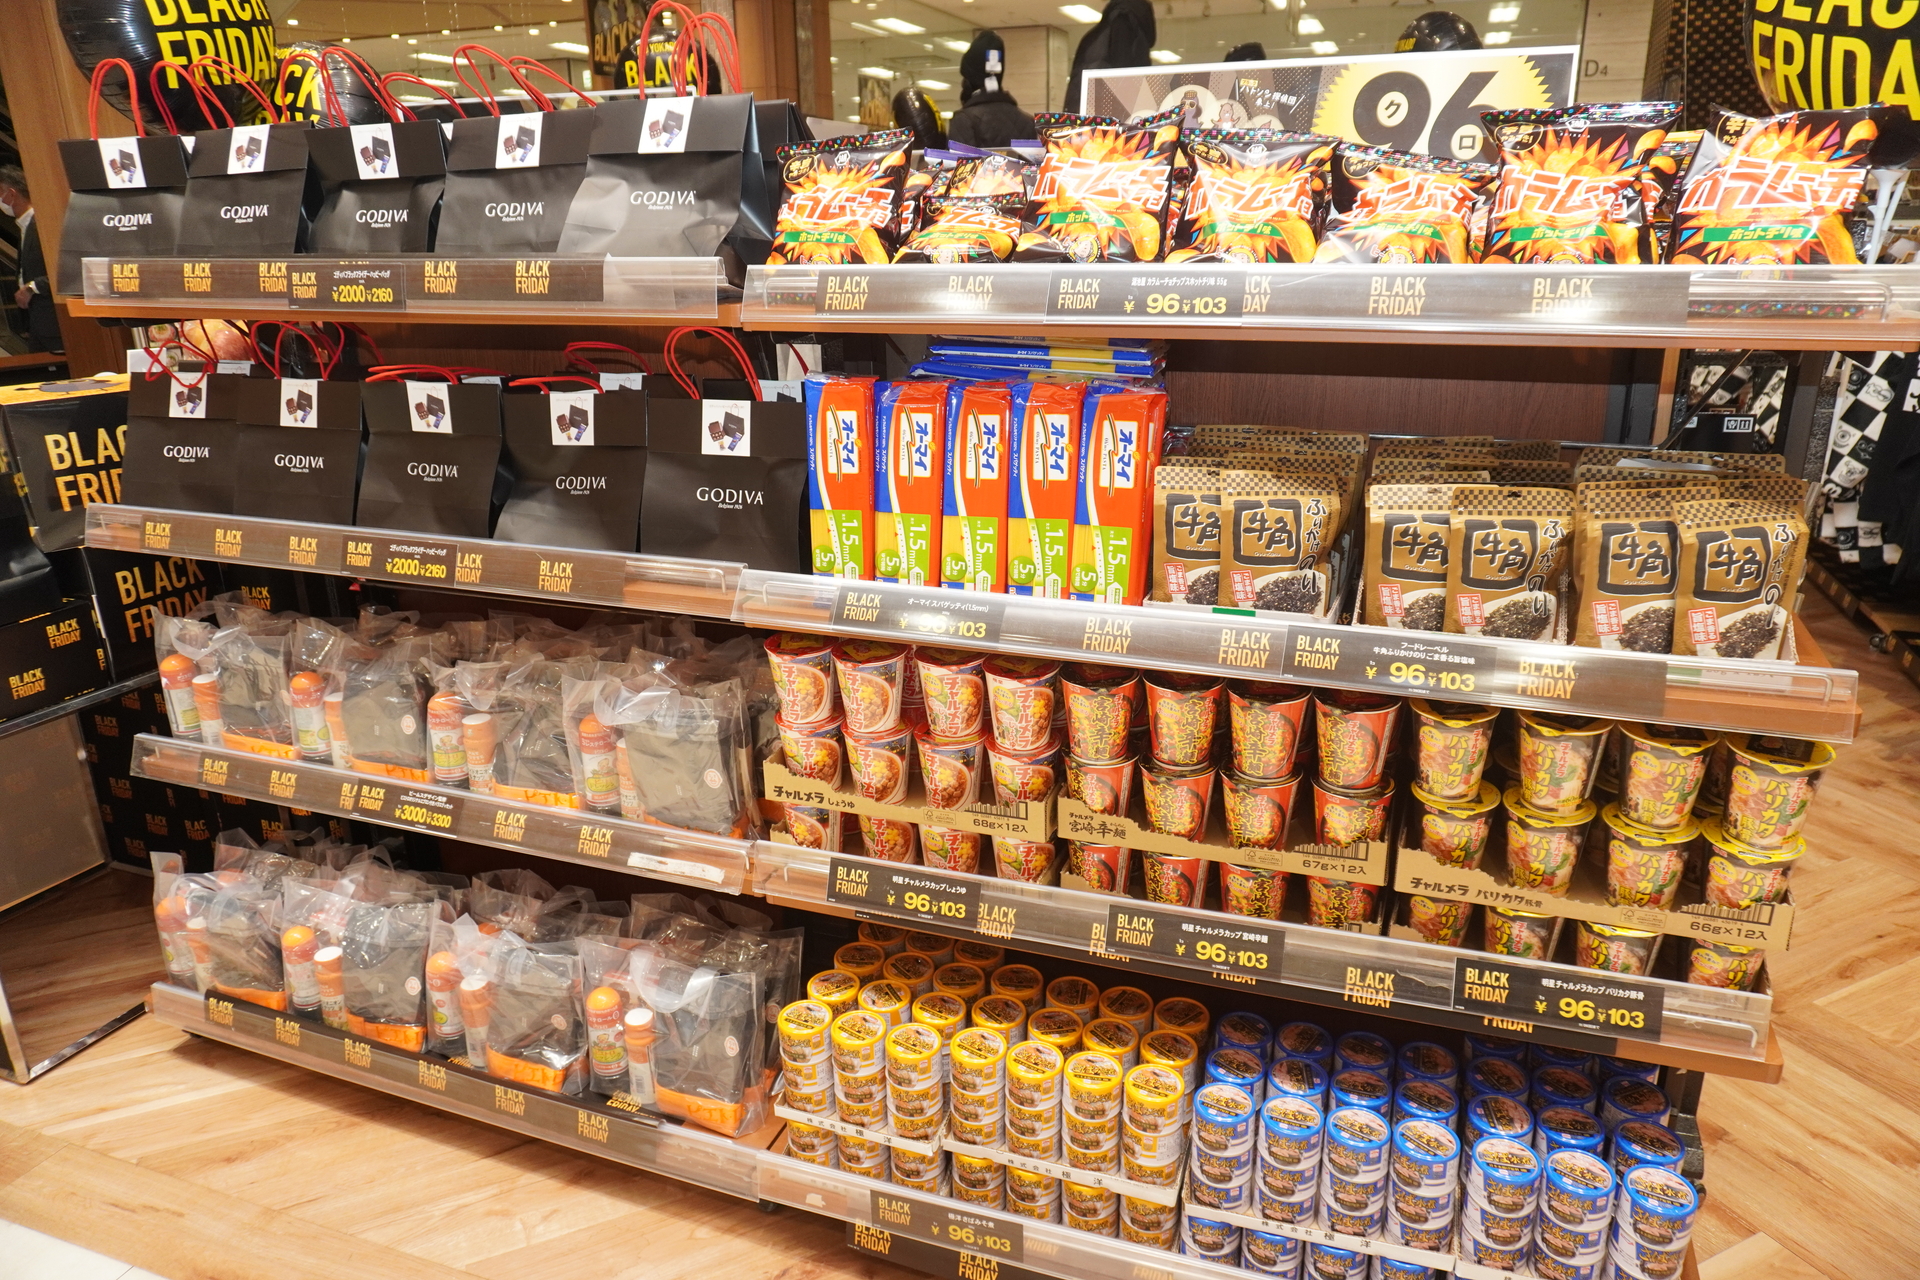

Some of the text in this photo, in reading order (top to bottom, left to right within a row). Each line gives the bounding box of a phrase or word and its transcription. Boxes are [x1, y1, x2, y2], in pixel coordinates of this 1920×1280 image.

[1352, 70, 1499, 163] 96
[1385, 99, 1401, 119] ク
[630, 190, 697, 205] GODIVA
[220, 204, 269, 219] GODIVA
[355, 209, 408, 223] GODIVA
[485, 201, 544, 217] GODIVA
[103, 213, 153, 226] GODIVA
[1728, 225, 1805, 241] ホットチリ味
[112, 264, 139, 278] BLACK
[184, 263, 212, 277] BLACK
[259, 262, 287, 277] BLACK
[292, 272, 317, 284] BLACK
[424, 261, 457, 277] BLACK
[515, 260, 550, 277] BLACK
[184, 278, 211, 292] FRIDAY
[259, 277, 287, 292] FRIDAY
[292, 285, 317, 298] FRIDAY
[424, 277, 457, 294] FRIDAY
[515, 277, 549, 294] FRIDAY
[827, 276, 870, 294] BLACK
[1370, 276, 1427, 296] BLACK
[1533, 277, 1594, 298] BLACK
[825, 293, 867, 310] FRIDAY
[1058, 294, 1099, 309] FRIDAY
[1146, 293, 1181, 314] 96
[1368, 296, 1426, 316] FRIDAY
[164, 445, 210, 458] GODIVA
[841, 418, 858, 469] オーマイ
[915, 420, 929, 470] オーマイ
[982, 423, 997, 474] オーマイ
[1050, 422, 1066, 474] オーマイ
[274, 454, 324, 469] GODIVA
[1117, 428, 1134, 482] オーマイ
[407, 462, 459, 478] GODIVA
[556, 475, 607, 490] GODIVA
[696, 487, 764, 505] GODIVA
[215, 528, 242, 543] BLACK
[1242, 510, 1297, 552] 牛角
[145, 535, 170, 549] FRIDAY
[215, 542, 242, 557] FRIDAY
[289, 536, 317, 552] BLACK
[840, 519, 859, 563] 1.5mm
[907, 522, 927, 568] 1.5mm
[975, 526, 994, 571] 1.5mm
[1044, 527, 1064, 574] 1.5mm
[1299, 498, 1328, 595] ふりかけのり
[1393, 525, 1448, 566] 牛角
[289, 550, 317, 565] FRIDAY
[346, 554, 371, 567] FRIDAY
[1106, 537, 1127, 583] 1.5mm
[1473, 531, 1528, 574] 牛角
[1611, 535, 1671, 579] 牛角
[1527, 519, 1565, 617] ふりかけのり
[1708, 542, 1764, 587] 牛角
[539, 576, 572, 593] FRIDAY
[846, 592, 882, 607] BLACK
[843, 606, 879, 622] FRIDAY
[46, 617, 79, 638] BLACK
[1085, 616, 1132, 636] BLACK
[49, 630, 82, 649] FRIDAY
[1082, 633, 1131, 654] FRIDAY
[1220, 628, 1271, 650] BLACK
[1296, 635, 1341, 654] BLACK
[1400, 642, 1449, 653] フードレーベル
[1218, 648, 1270, 669] FRIDAY
[1294, 652, 1340, 671] FRIDAY
[1373, 646, 1476, 665] 牛角ふりかけのりごま香る旨塩味
[1365, 666, 1378, 679] ¥
[1389, 662, 1426, 685] 96
[1519, 656, 1577, 679] BLACK
[11, 680, 45, 700] FRIDAY
[781, 665, 801, 724] チャルメラ
[1517, 677, 1576, 699] FRIDAY
[847, 671, 864, 731] チャルメラ
[944, 675, 961, 736] チャルメラ
[1017, 688, 1035, 750] チャルメラ
[204, 758, 229, 774] BLACK
[1446, 735, 1469, 789] バリカタ
[1535, 742, 1555, 799] バリカタ
[202, 771, 227, 787] FRIDAY
[270, 770, 297, 787] BLACK
[269, 783, 295, 799] FRIDAY
[361, 785, 385, 799] BLACK
[774, 785, 856, 808] チャルメラ しょうゆ
[1657, 761, 1689, 817] バリカタ
[359, 797, 383, 811] FRIDAY
[1759, 778, 1790, 837] バリカタ
[495, 810, 527, 829] BLACK
[973, 818, 1028, 834] 68g×12入
[493, 825, 524, 842] FRIDAY
[580, 825, 614, 843] BLACK
[1068, 820, 1127, 840] 宮崎辛麺
[578, 840, 612, 858] FRIDAY
[1302, 859, 1367, 876] 67g×12入
[835, 880, 868, 897] FRIDAY
[1410, 877, 1469, 897] チャルメラ
[904, 891, 930, 912] 96
[1117, 913, 1155, 932] BLACK
[1195, 925, 1242, 939] チャルメラカップ
[1689, 920, 1768, 942] 66g×12入
[1116, 928, 1153, 947] FRIDAY
[1195, 941, 1227, 963] 96
[1346, 966, 1395, 991] BLACK
[1465, 967, 1510, 988] BLACK
[1343, 985, 1394, 1008] FRIDAY
[1556, 980, 1605, 995] チャルメラカップ
[209, 1010, 234, 1026] FRIDAY
[1534, 1001, 1547, 1014] ¥
[1558, 997, 1596, 1021] 96
[275, 1017, 300, 1036] BLACK
[275, 1030, 300, 1047] FRIDAY
[418, 1060, 446, 1078] BLACK
[495, 1085, 525, 1104] BLACK
[495, 1097, 525, 1116] FRIDAY
[879, 1209, 911, 1226] FRIDAY
[948, 1224, 975, 1244] 96
